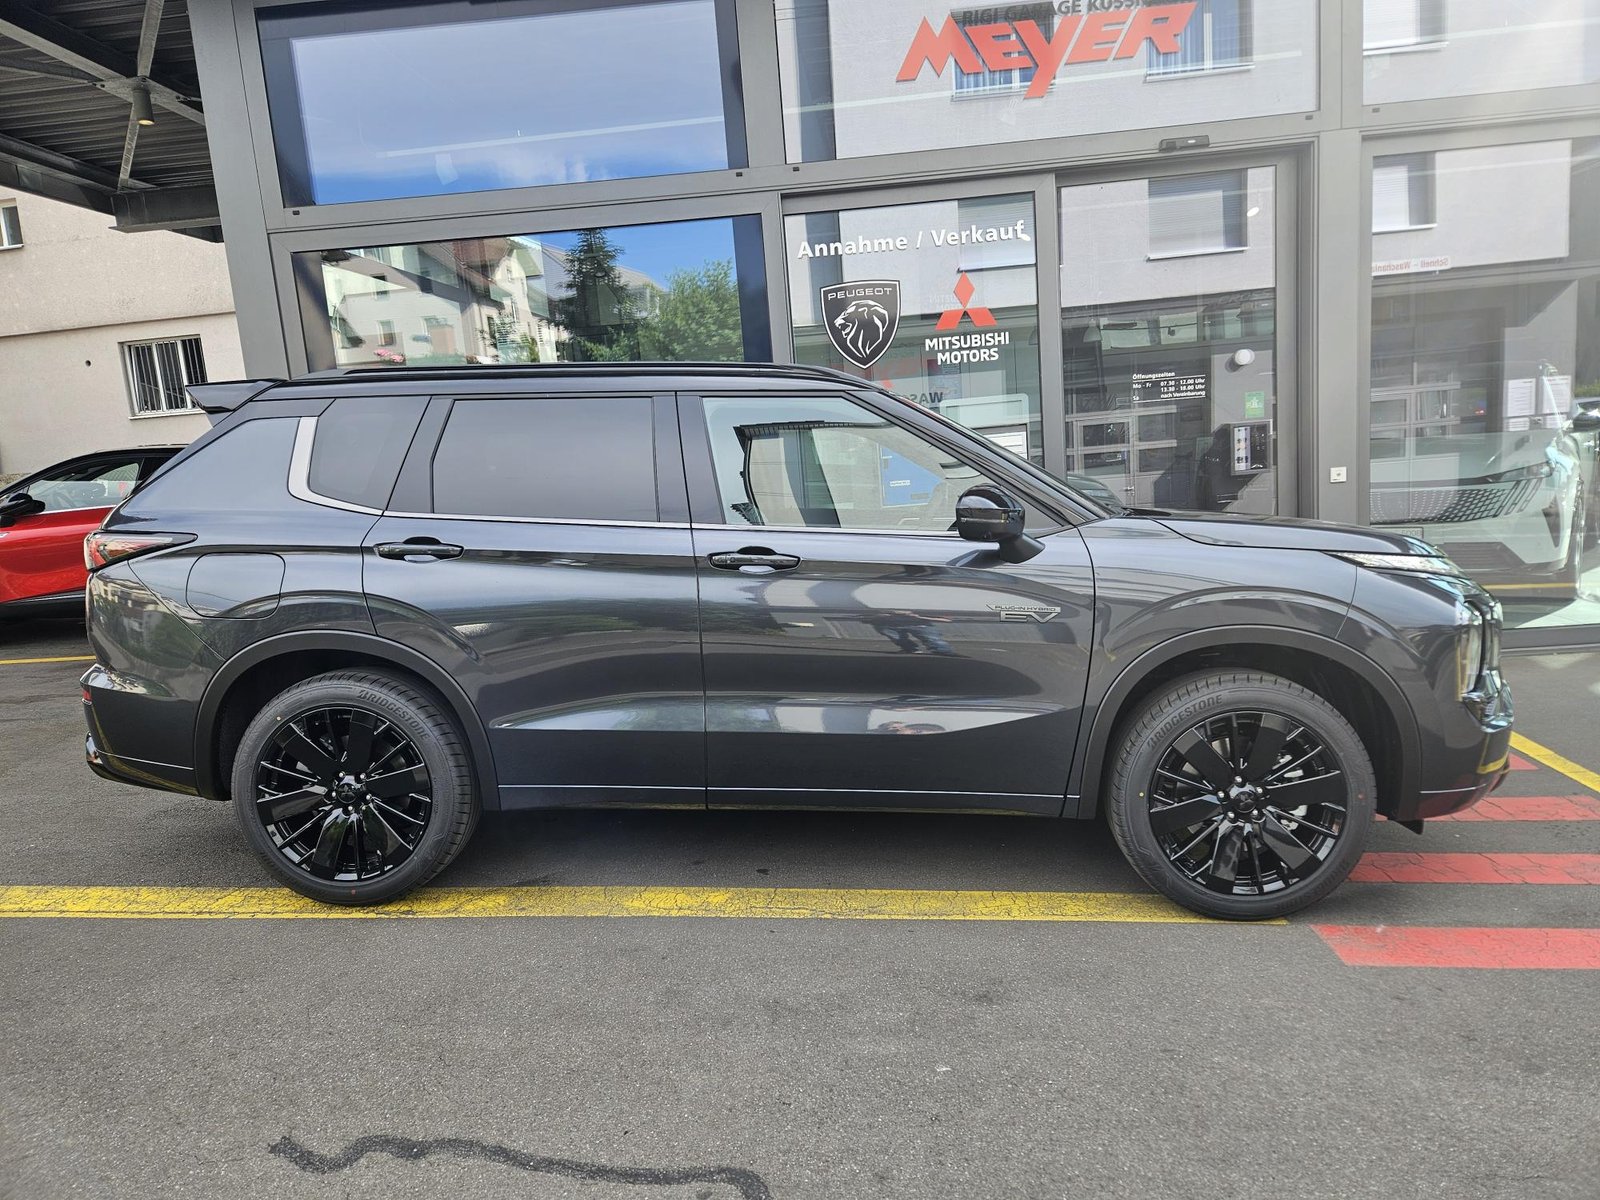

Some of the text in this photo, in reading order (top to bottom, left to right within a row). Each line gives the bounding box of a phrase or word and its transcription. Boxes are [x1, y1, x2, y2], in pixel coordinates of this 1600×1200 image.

[962, 7, 999, 25] RIGI
[1004, 0, 1083, 23] GARAGE
[896, 2, 1198, 100] MEYER
[797, 220, 1026, 259] Annahme / Verkauf
[827, 287, 893, 300] PEUGEOT
[925, 331, 1010, 351] MITSUBISHI
[937, 347, 999, 365] MOTORS
[1132, 372, 1175, 380] Öffnungszeiten
[1173, 390, 1205, 398] Vereinbarung
[1000, 611, 1059, 624] EV
[356, 689, 429, 741] BRIDGESTONE
[1147, 694, 1223, 749] BRIDGESTONE
